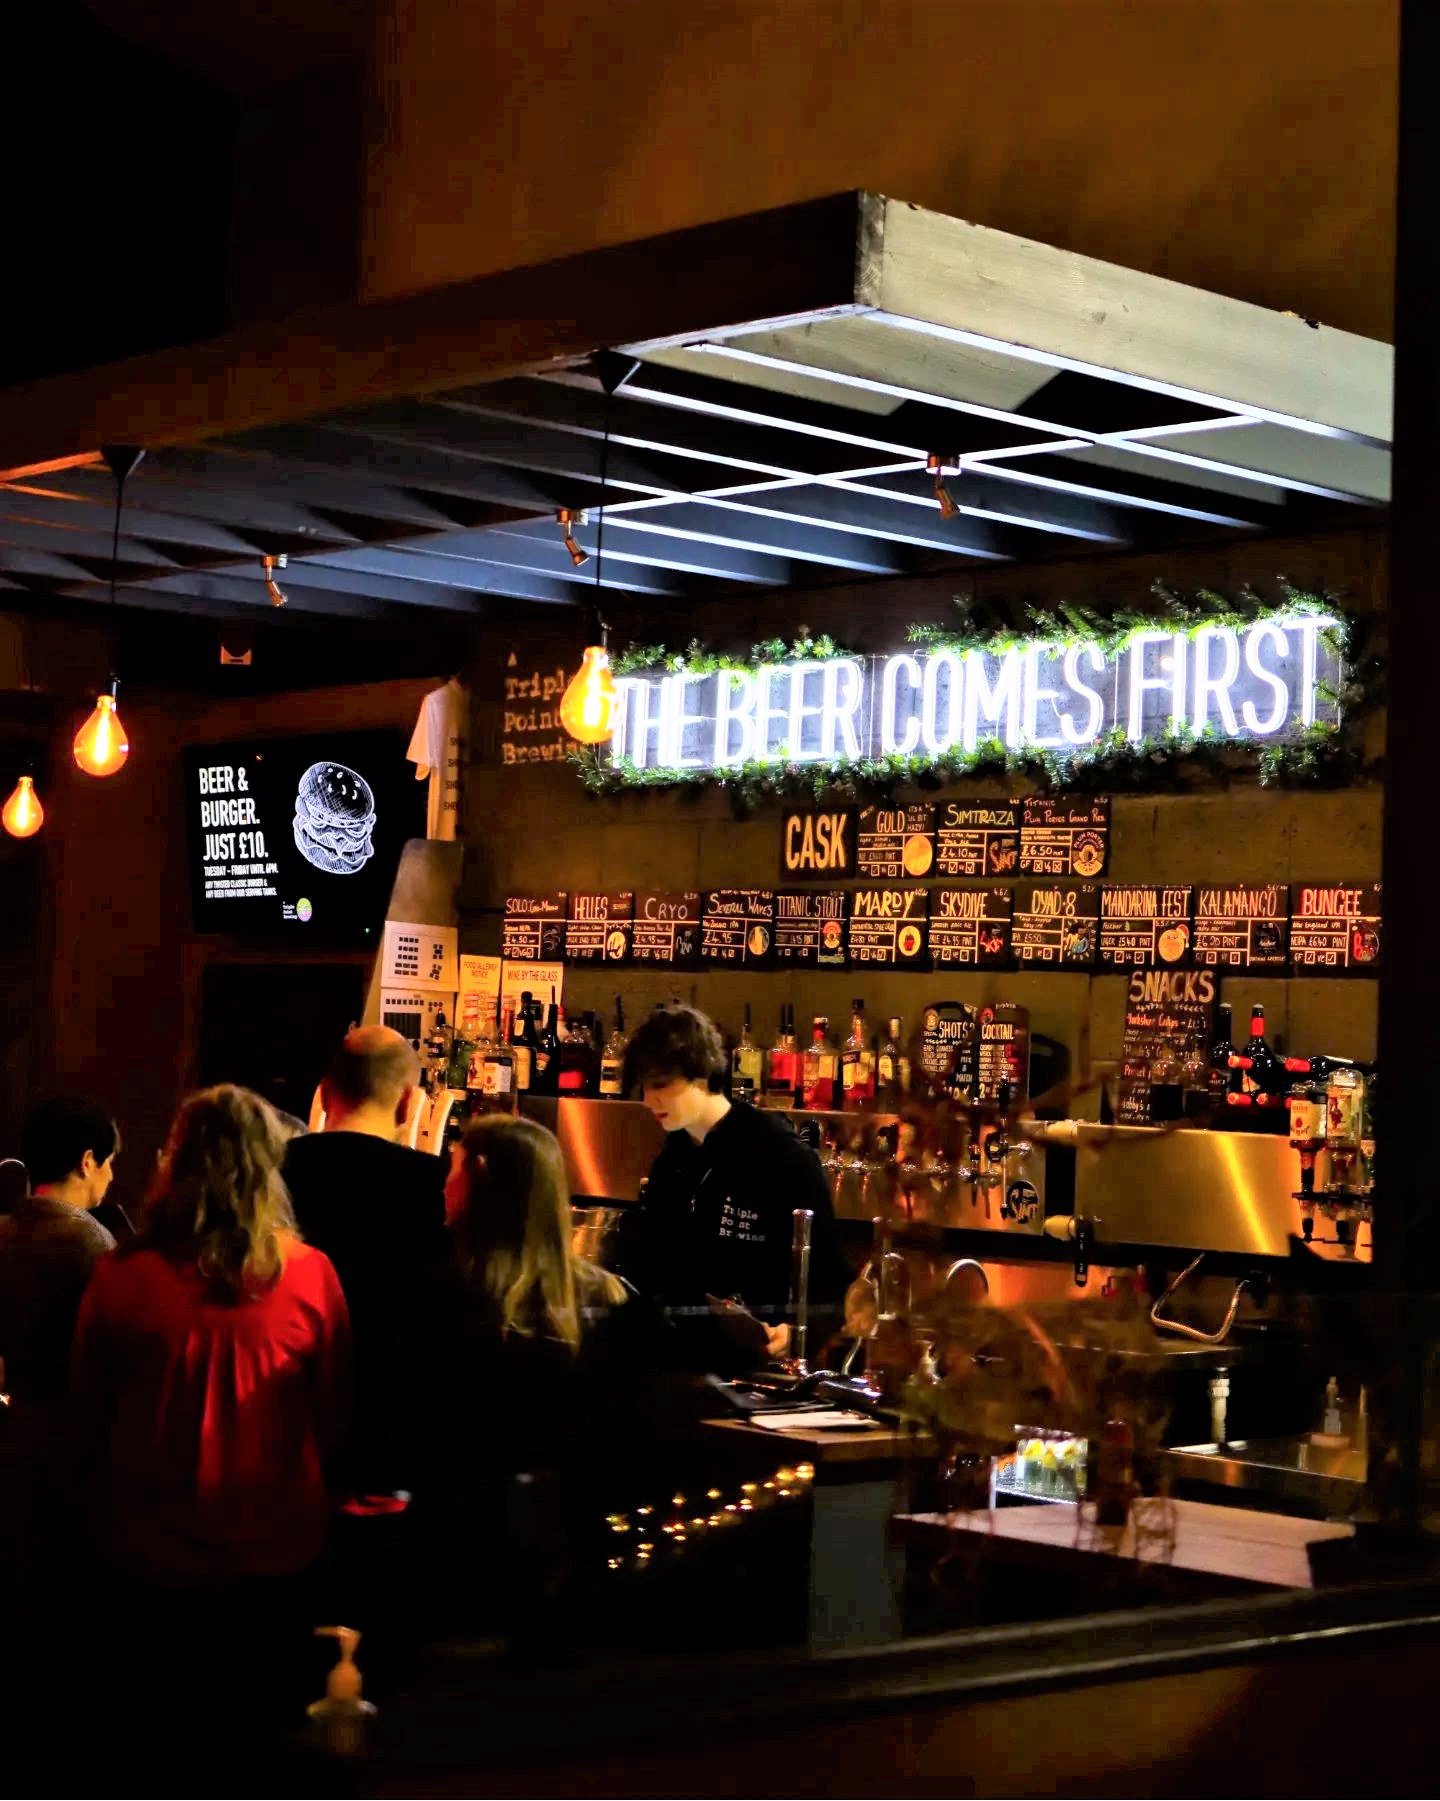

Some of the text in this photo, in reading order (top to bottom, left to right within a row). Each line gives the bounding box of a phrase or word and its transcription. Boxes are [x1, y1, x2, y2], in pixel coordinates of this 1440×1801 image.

[505, 668, 569, 701] Tripl
[611, 617, 1340, 768] THE BEER COMES FIRST
[199, 766, 248, 794] BEER &
[201, 798, 260, 827] BURGER.
[1024, 798, 1056, 807] TITANIC
[877, 810, 905, 833] GOLD
[945, 804, 1015, 827] SIMTRAZA
[203, 831, 269, 860] JUST £10.
[786, 814, 847, 869] CASK
[1021, 845, 1053, 856] £6.50
[204, 866, 226, 876] TUESDAY
[231, 864, 249, 875] FRIDAY
[250, 864, 265, 875] UNTIL
[1020, 860, 1031, 869] GF
[575, 896, 608, 920] HELLES
[645, 897, 688, 920] CRYO
[708, 893, 745, 914] SEVERAL
[748, 896, 773, 917] WAVES
[777, 896, 845, 919] TITANIC STOUT
[854, 891, 915, 918] MARDY
[940, 891, 988, 918] SKYDIVE
[1101, 889, 1191, 917] MANDARINA FEST
[1200, 889, 1277, 917] KALAMANGO
[1302, 889, 1362, 916] BUNGEE
[508, 970, 557, 982] WINE BY THE GLASS
[1129, 970, 1214, 1003] SNACKS
[939, 1021, 968, 1039] SHOTS
